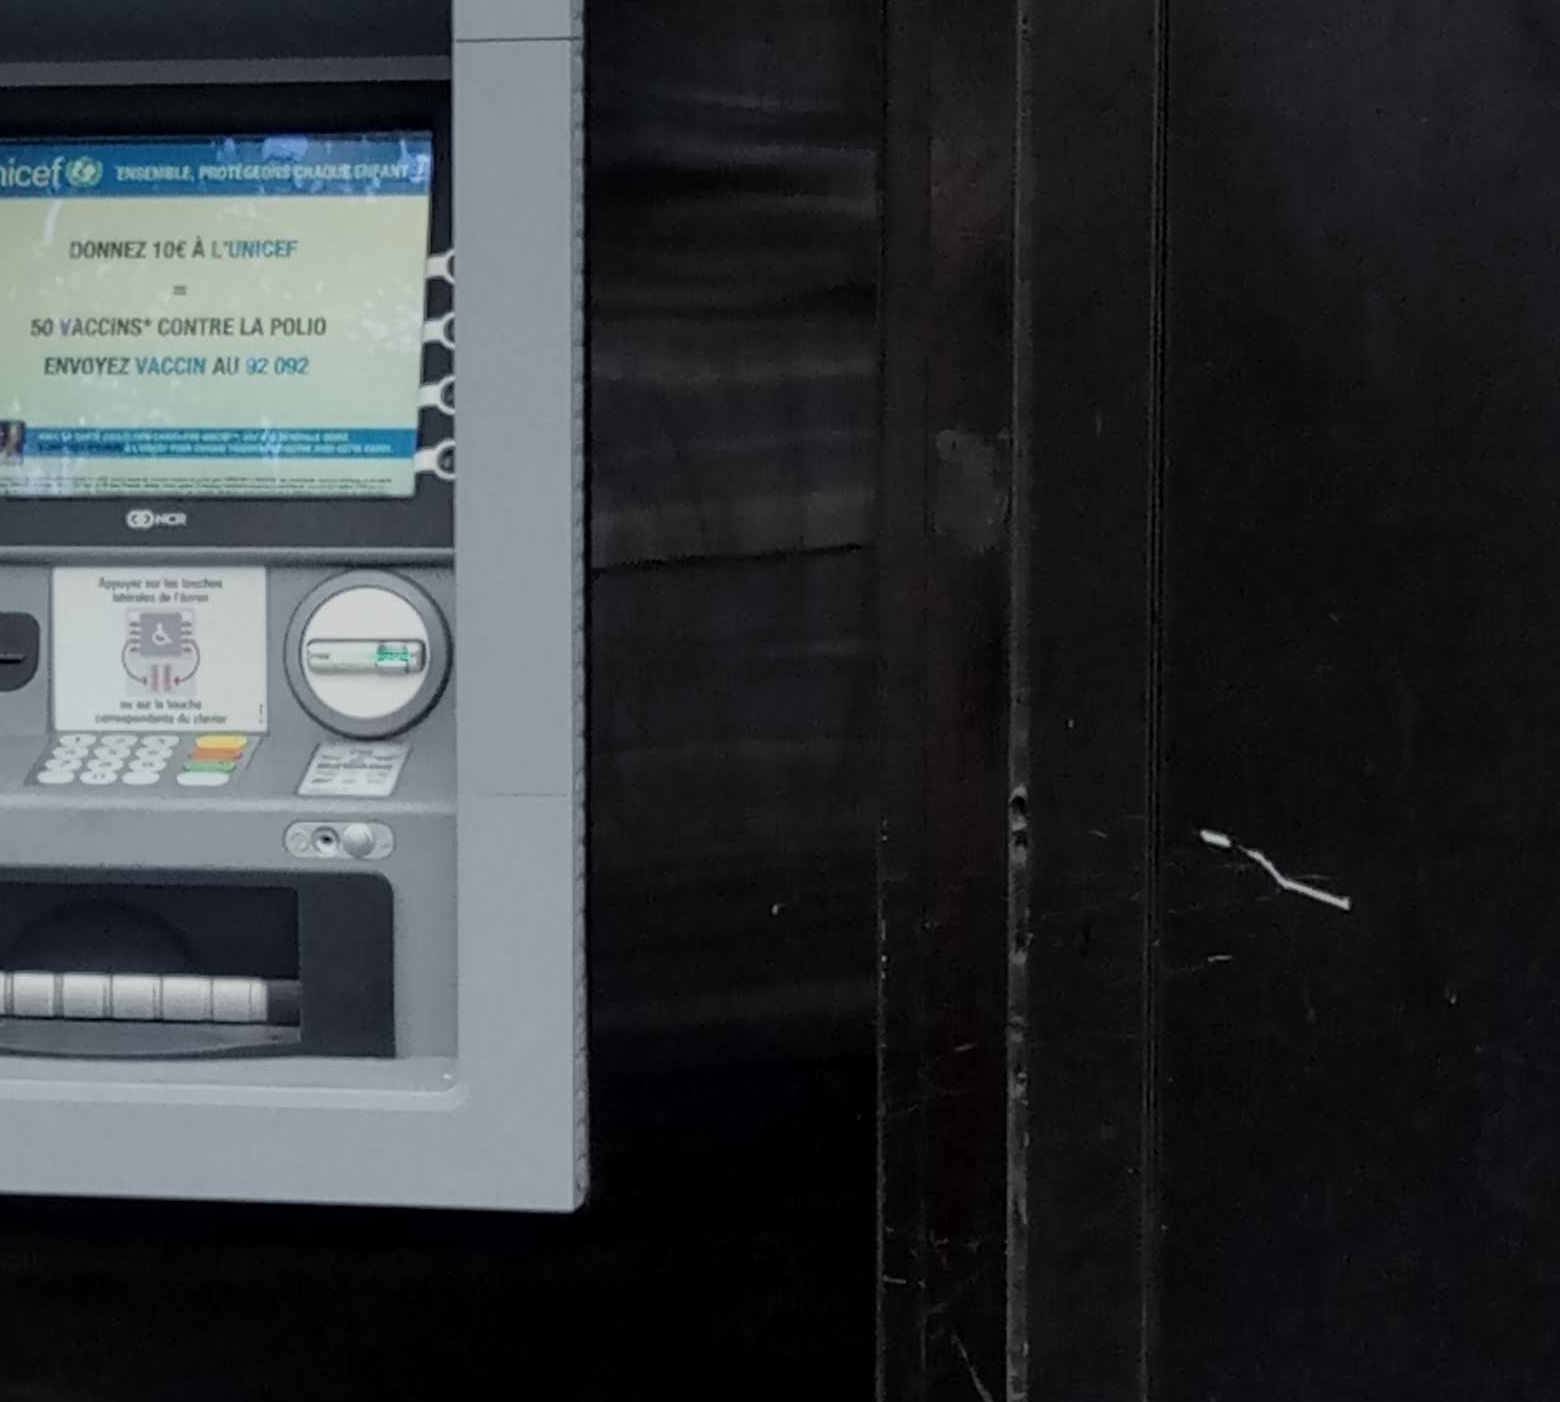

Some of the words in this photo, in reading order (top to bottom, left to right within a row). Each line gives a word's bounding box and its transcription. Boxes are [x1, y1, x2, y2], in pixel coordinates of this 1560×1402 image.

[69, 240, 147, 259] DONNEZ
[153, 240, 187, 259] 10€
[192, 236, 205, 259] À
[211, 240, 298, 259] L'UNICEF
[30, 318, 54, 337] 50
[157, 317, 235, 336] CONTRE
[240, 318, 264, 336] LA
[270, 317, 327, 336] POLIO
[43, 356, 130, 375] ENVOYEZ
[135, 356, 206, 375] VACCIN
[212, 357, 239, 375] AU
[246, 357, 269, 375] 92
[274, 356, 310, 375] 092
[155, 513, 187, 526] NCR
